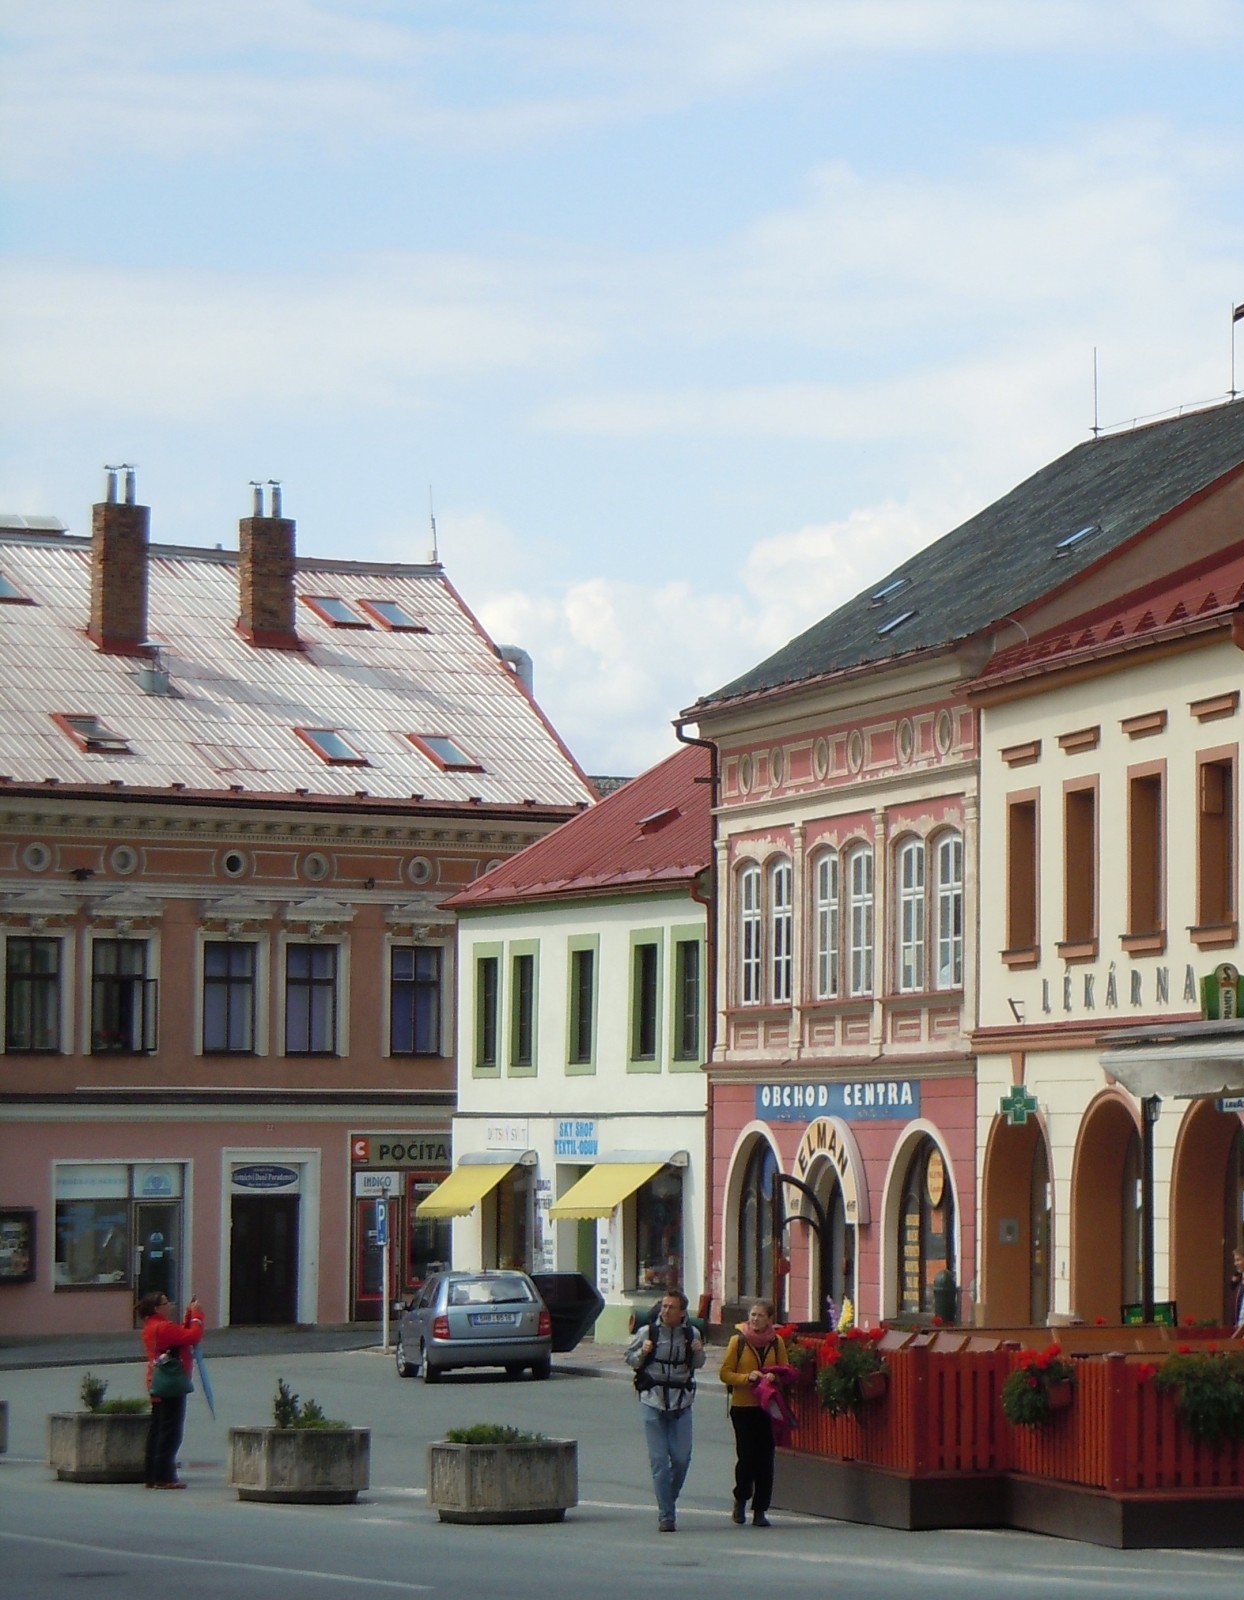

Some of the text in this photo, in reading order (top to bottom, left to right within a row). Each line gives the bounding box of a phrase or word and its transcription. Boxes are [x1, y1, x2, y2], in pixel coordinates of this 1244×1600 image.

[1041, 960, 1197, 1016] LÉKÁRNA
[761, 1082, 913, 1107] OBCHOD CENTRA
[559, 1122, 594, 1137] SKY SHOP
[379, 1140, 452, 1161] POČÍTA
[797, 1122, 848, 1177] ELMAN
[378, 1205, 386, 1229] P
